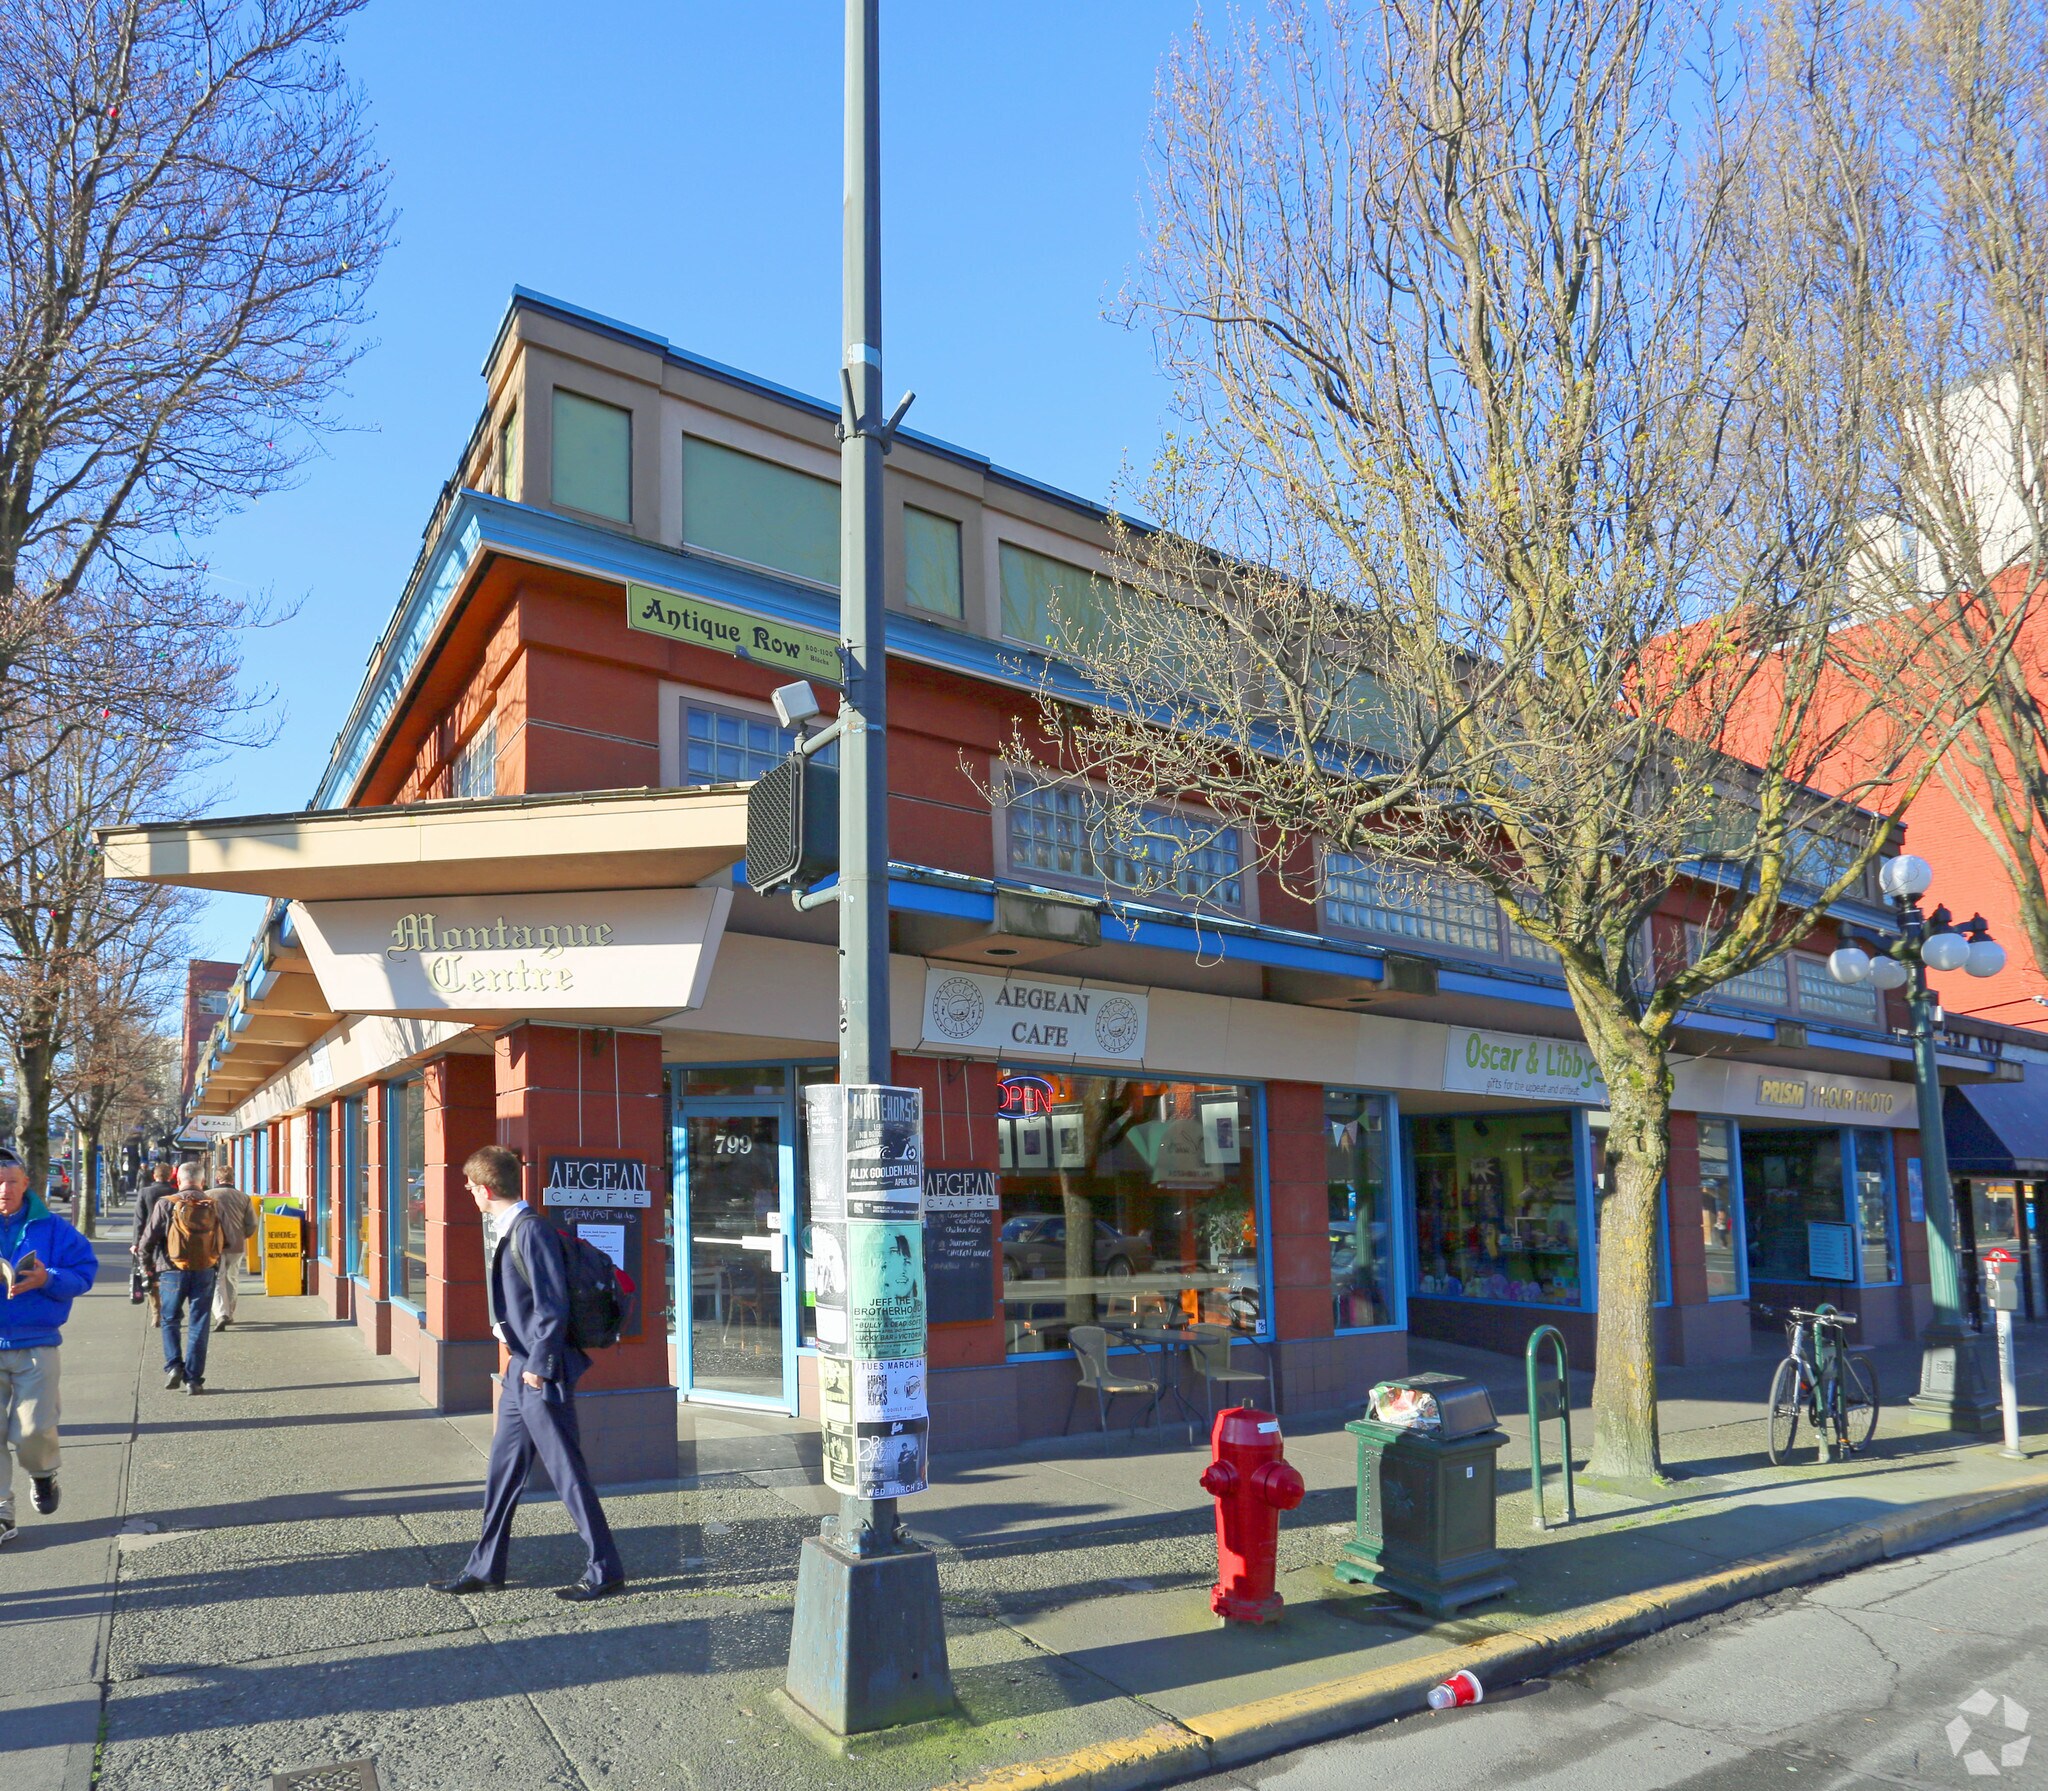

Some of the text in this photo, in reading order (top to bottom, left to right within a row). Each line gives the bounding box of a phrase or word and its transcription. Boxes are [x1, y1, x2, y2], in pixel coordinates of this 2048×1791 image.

[642, 598, 801, 659] Antique Row
[386, 912, 614, 962] Montague
[427, 953, 574, 993] Centre
[995, 985, 1091, 1016] AEGEAN
[1011, 1021, 1069, 1048] CAFE
[1466, 1032, 1524, 1073] Oscar
[1526, 1041, 1539, 1075] &
[1504, 1079, 1514, 1090] for
[853, 1092, 918, 1123] WHITEHORSE
[1761, 1081, 1805, 1105] PRISM
[1854, 1090, 1894, 1114] PHOTO
[714, 1134, 752, 1154] 799
[547, 1161, 647, 1191] AEGEAN
[850, 1164, 918, 1179] ALIX GOOLDEN HALL
[894, 1178, 908, 1187] APRIL
[926, 1172, 995, 1197] AEGEAN
[563, 1207, 613, 1225] BREAKFAST
[870, 1296, 911, 1306] JEFF THE
[890, 1320, 908, 1328] DEAD
[855, 1333, 879, 1342] LUCKY
[861, 1362, 885, 1370] TUES
[887, 1360, 914, 1370] MARCH
[866, 1481, 924, 1497] WED MARCH 25
